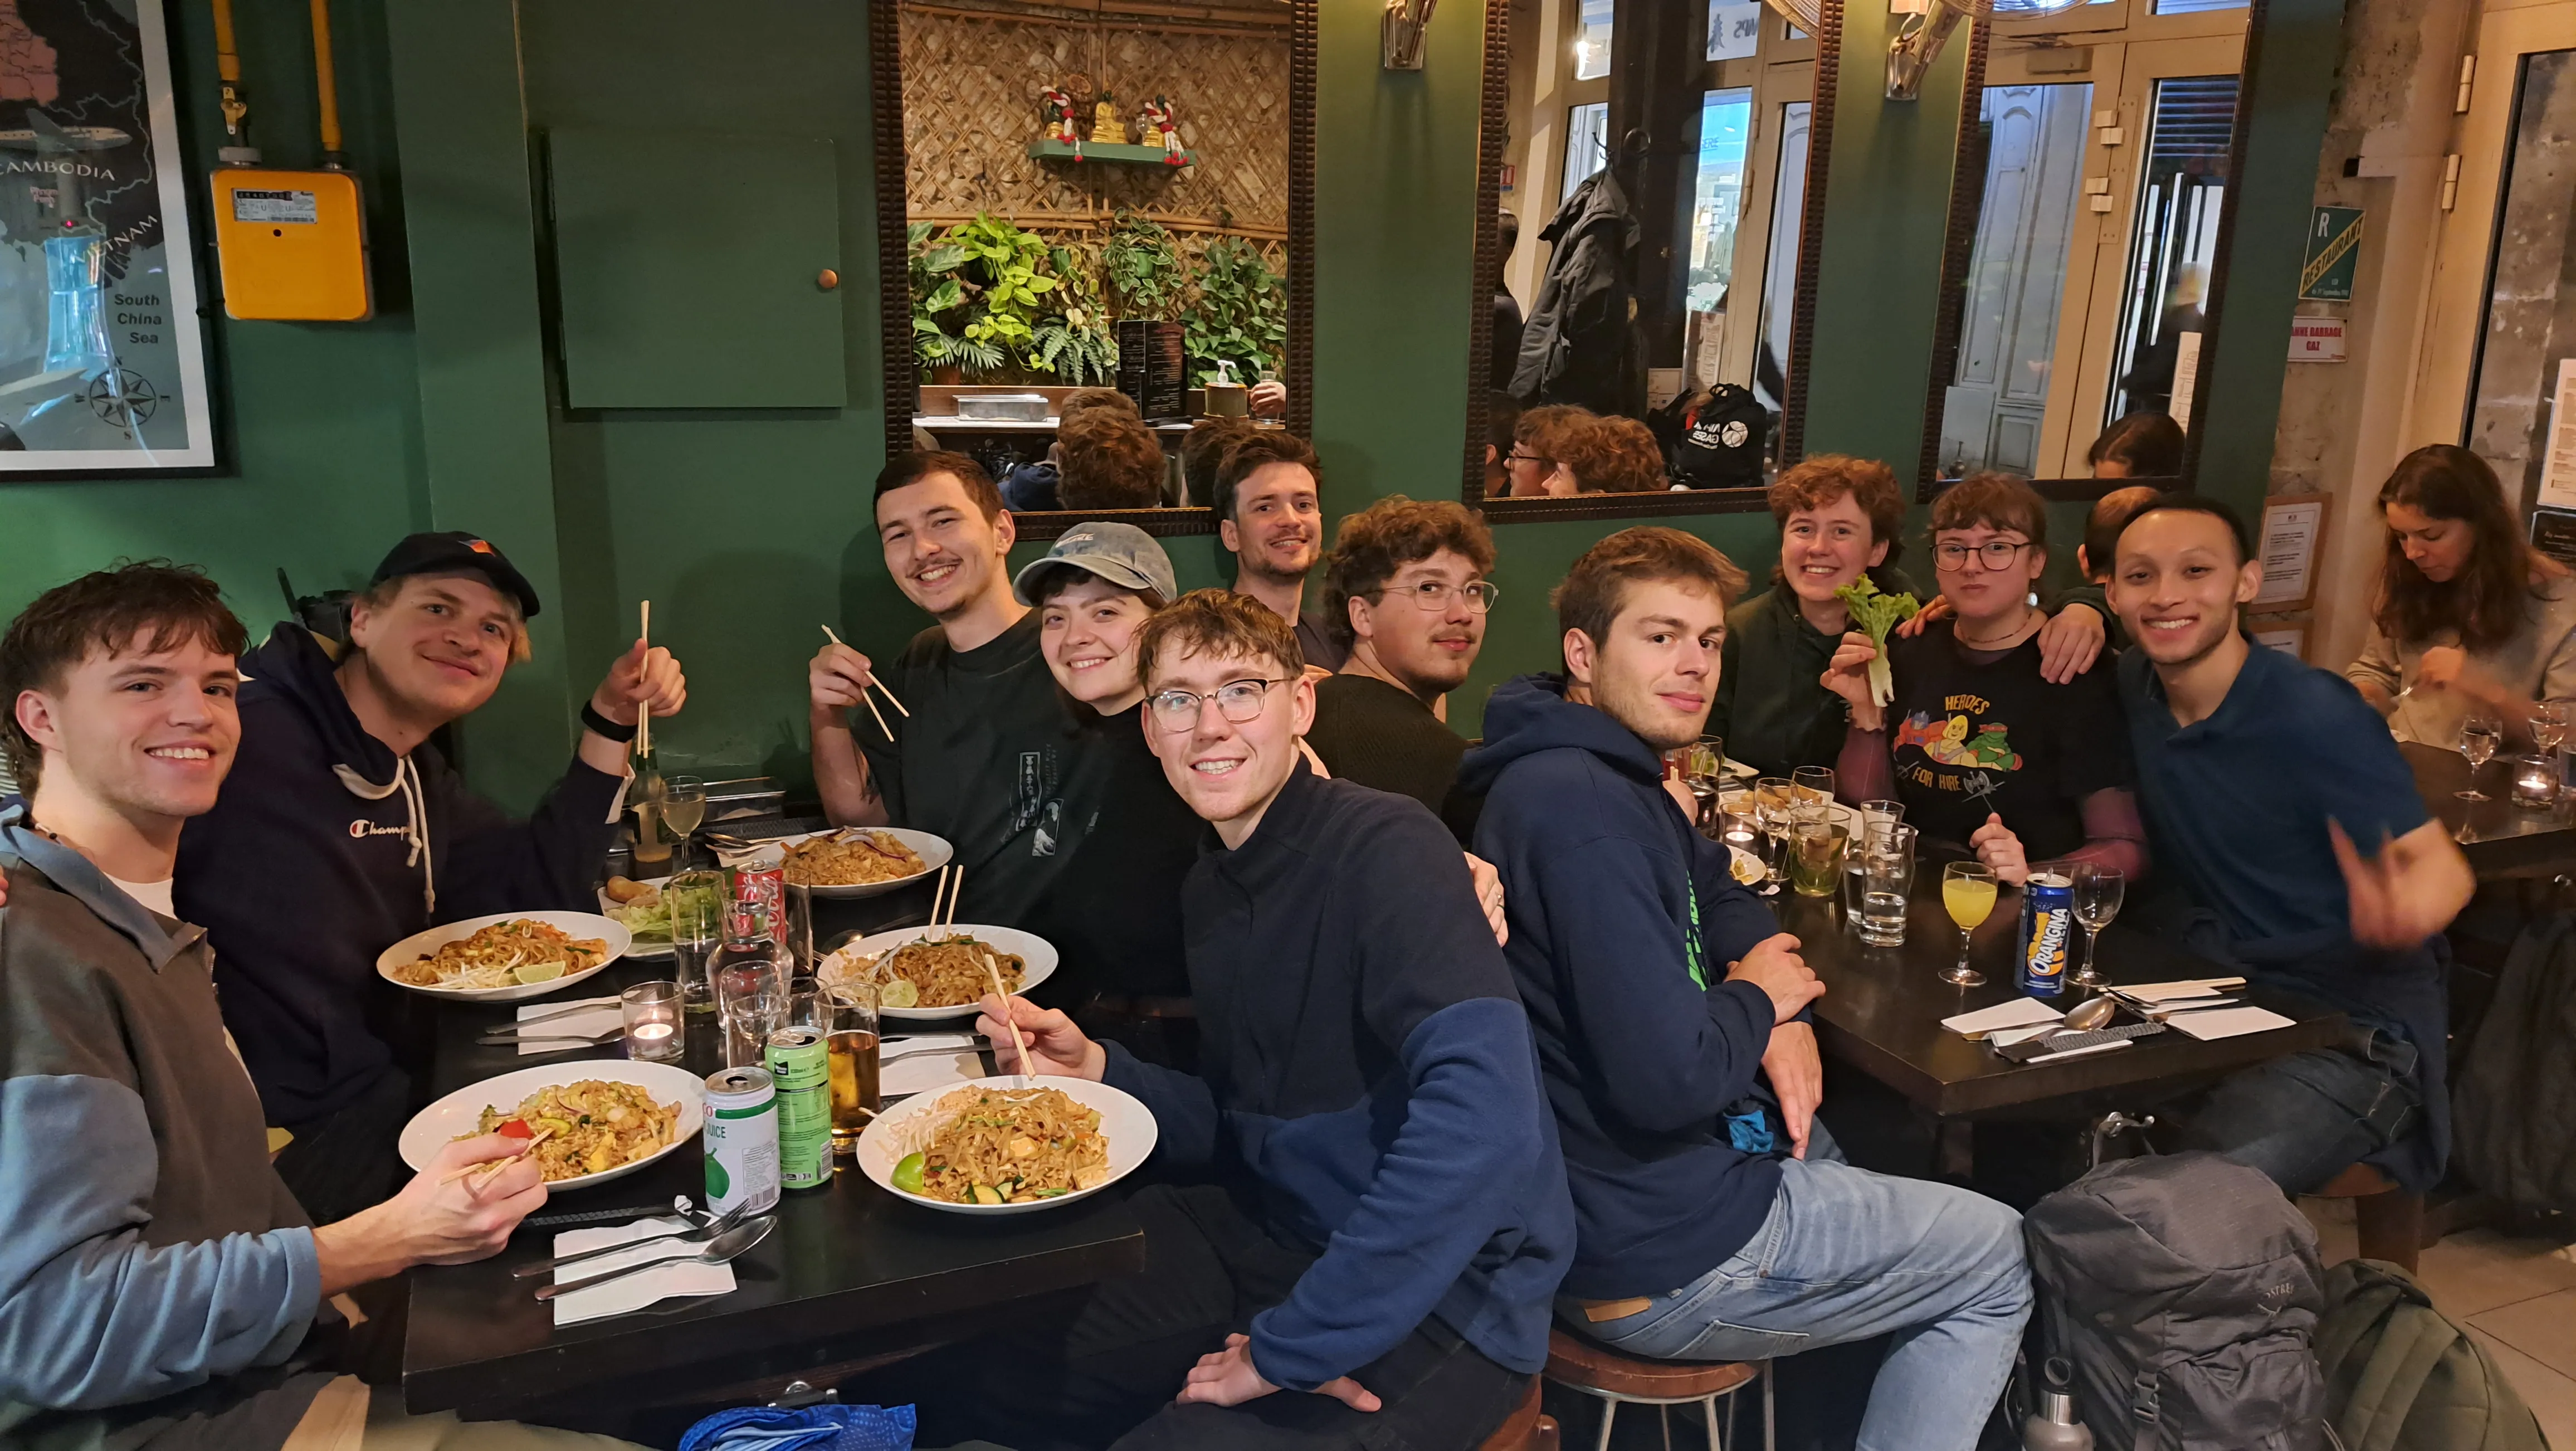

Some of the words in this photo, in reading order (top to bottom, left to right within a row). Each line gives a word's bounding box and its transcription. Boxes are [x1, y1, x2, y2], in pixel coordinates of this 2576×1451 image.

[2318, 212, 2330, 237] R
[2302, 216, 2364, 291] RESTAURANT
[114, 294, 159, 305] South
[117, 313, 162, 325] China
[129, 332, 158, 344] Sea
[2310, 327, 2342, 337] BARRAGE
[2306, 340, 2320, 351] GAZ
[124, 431, 131, 440] S
[1945, 694, 1990, 715] HEROES
[1911, 767, 1934, 788] FOR
[1938, 773, 1962, 792] HIRE
[2029, 908, 2068, 974] ORANGINA
